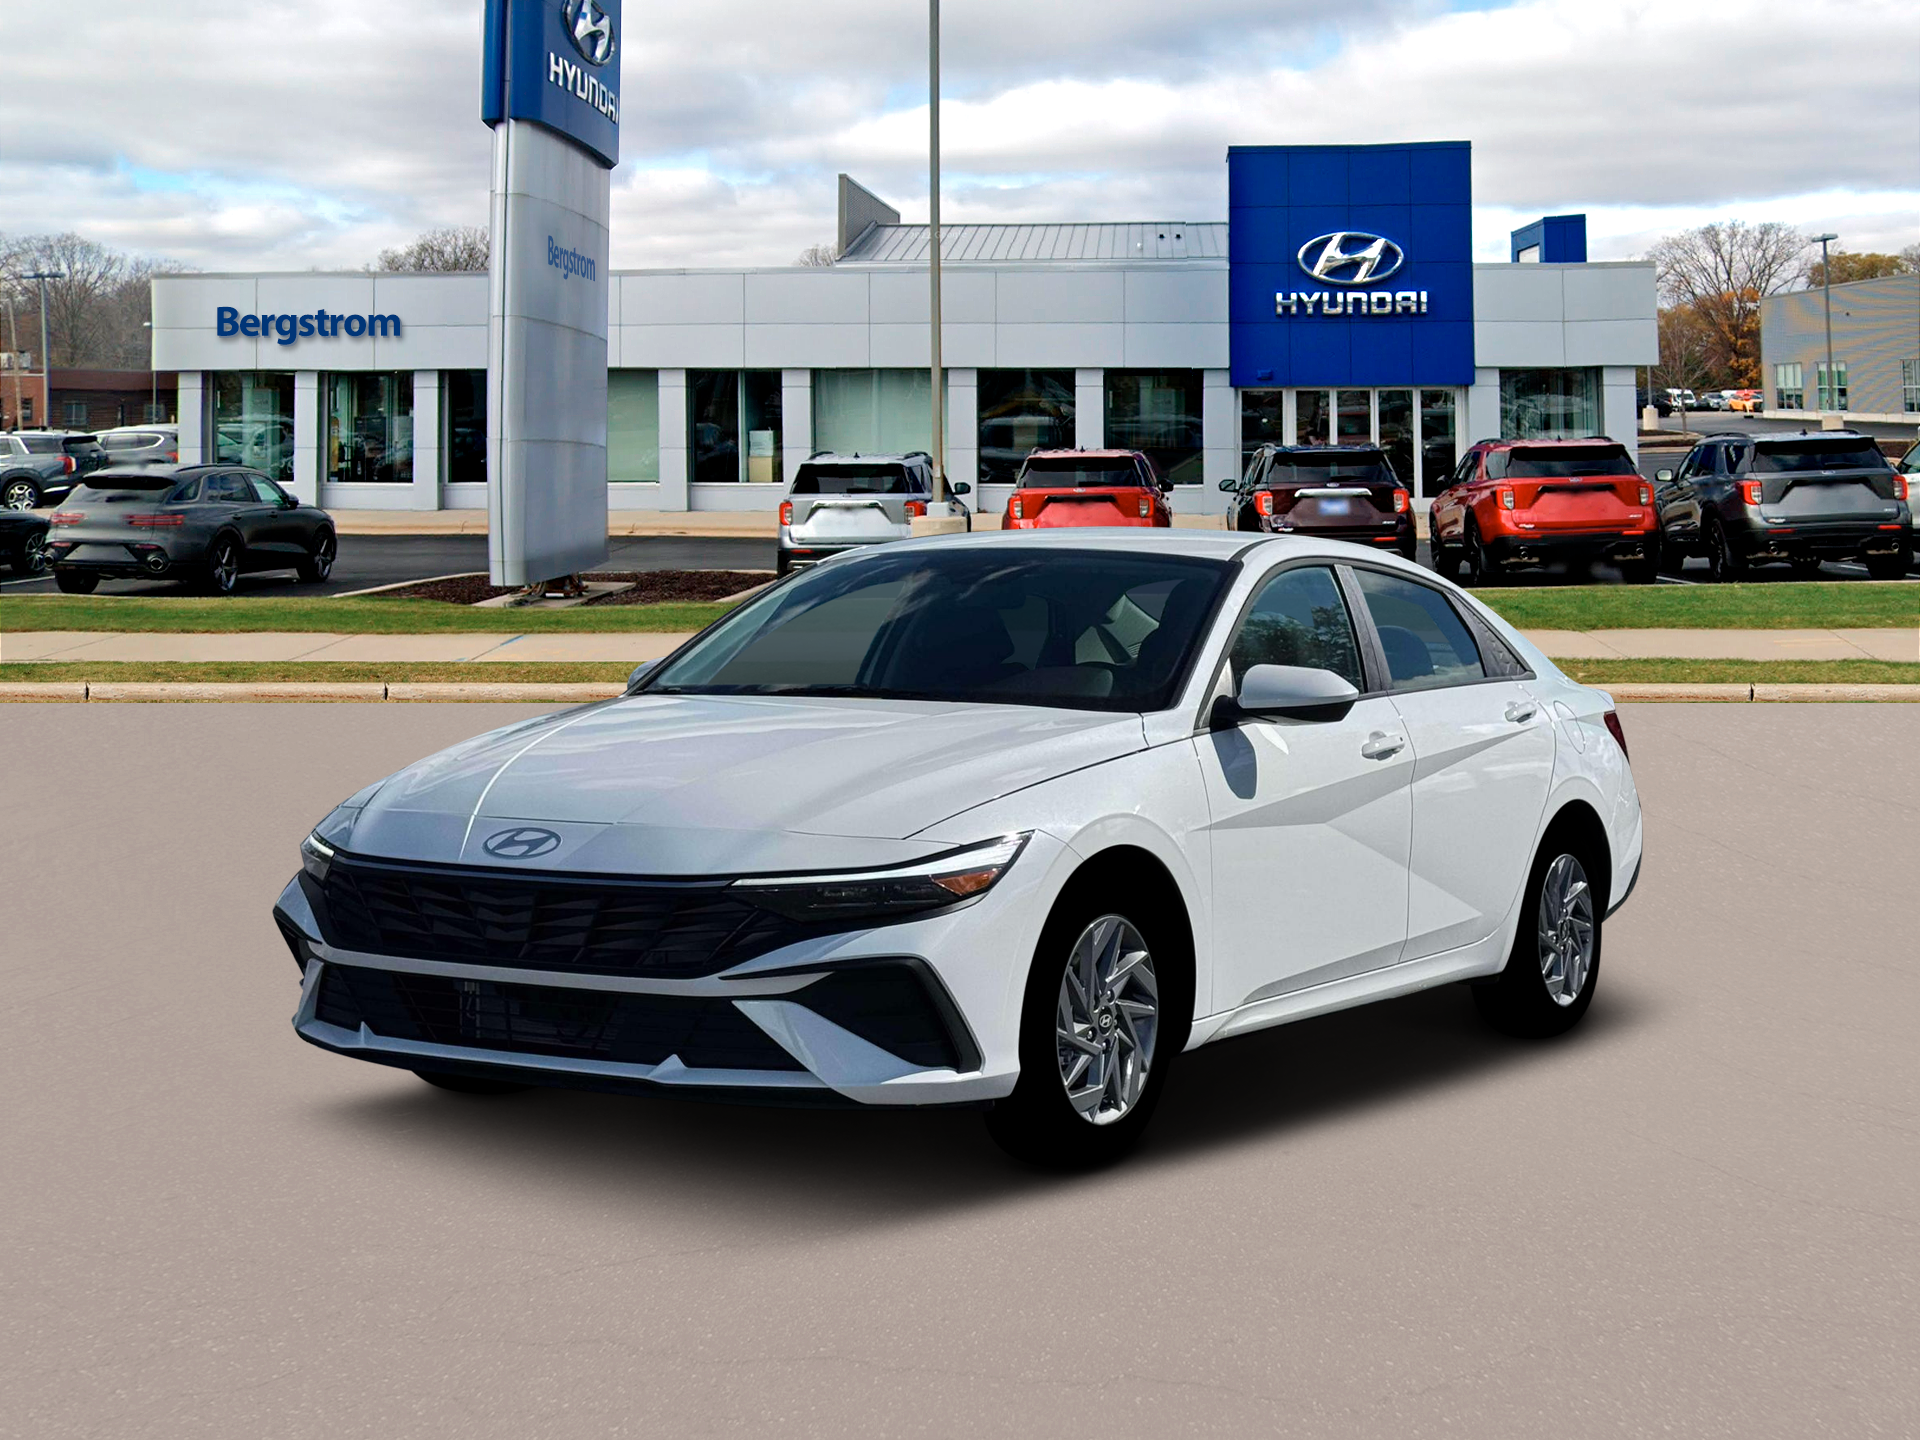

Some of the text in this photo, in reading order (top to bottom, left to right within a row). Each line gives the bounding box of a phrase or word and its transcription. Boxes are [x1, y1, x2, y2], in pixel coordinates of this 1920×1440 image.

[549, 51, 619, 124] HYUNDAI
[547, 235, 596, 282] Bergstrom
[1275, 290, 1428, 315] HYUNDAI
[216, 306, 402, 346] Bergstrom
